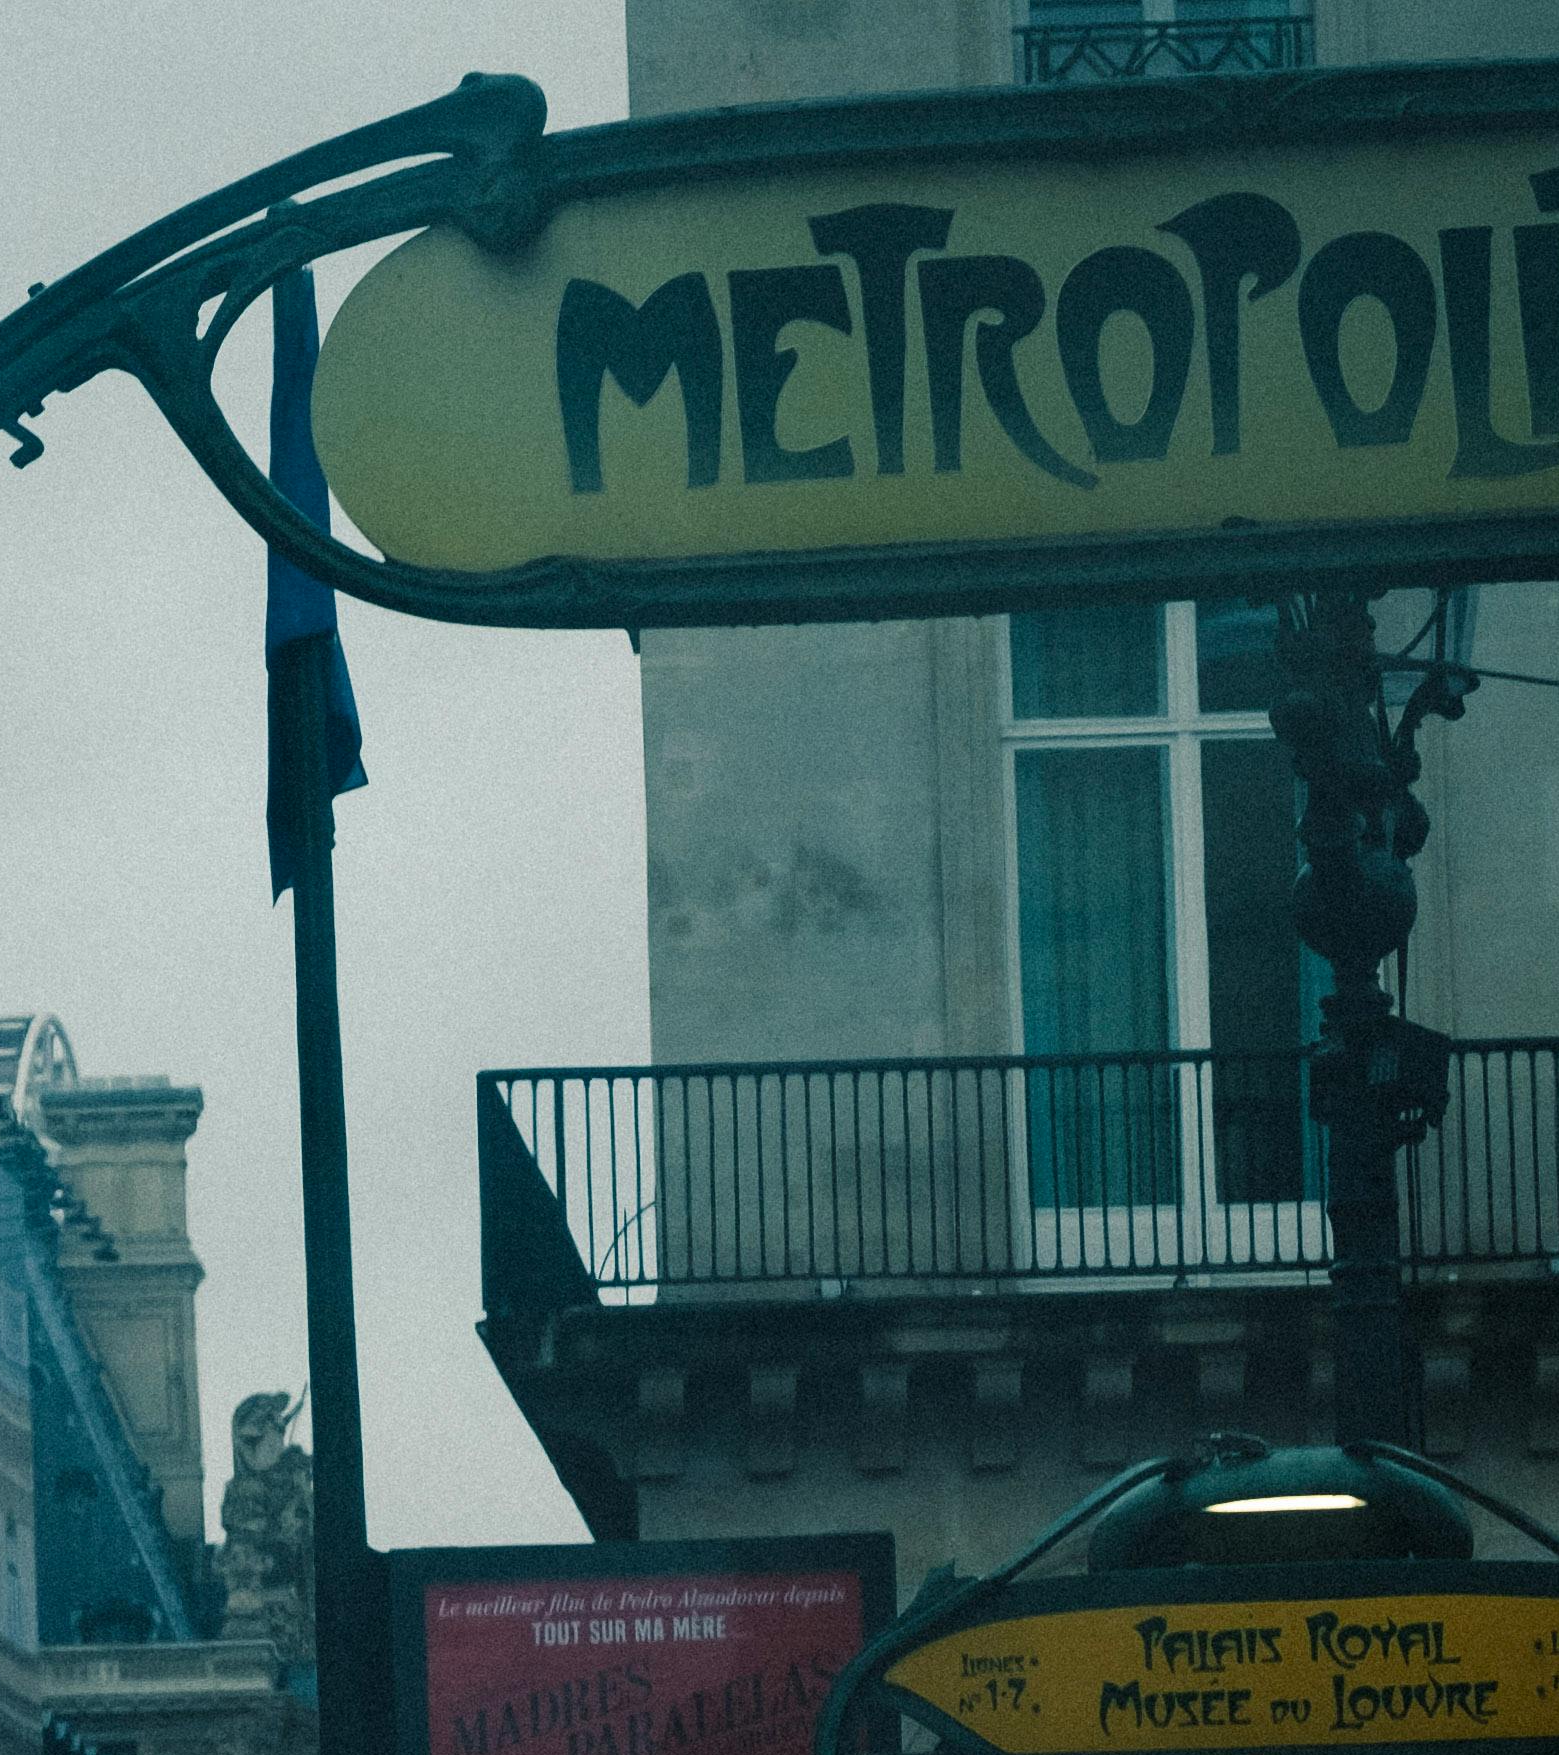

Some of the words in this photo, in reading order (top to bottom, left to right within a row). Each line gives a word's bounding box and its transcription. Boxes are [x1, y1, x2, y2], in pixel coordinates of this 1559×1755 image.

[437, 1598, 460, 1618] Le
[465, 1595, 546, 1617] meilleur
[546, 1594, 585, 1619] film
[591, 1594, 614, 1611] de
[619, 1590, 673, 1612] Pedro
[784, 1584, 847, 1608] depuis
[532, 1620, 581, 1647] TOUT
[589, 1617, 627, 1644] SUR
[635, 1616, 665, 1642] MA
[672, 1608, 728, 1640] MÈRE
[1134, 1615, 1282, 1672] PALAIS
[1306, 1611, 1461, 1670] ROYAL
[1098, 1678, 1253, 1737] MUSÉE
[1330, 1673, 1499, 1731] LOUVRE
